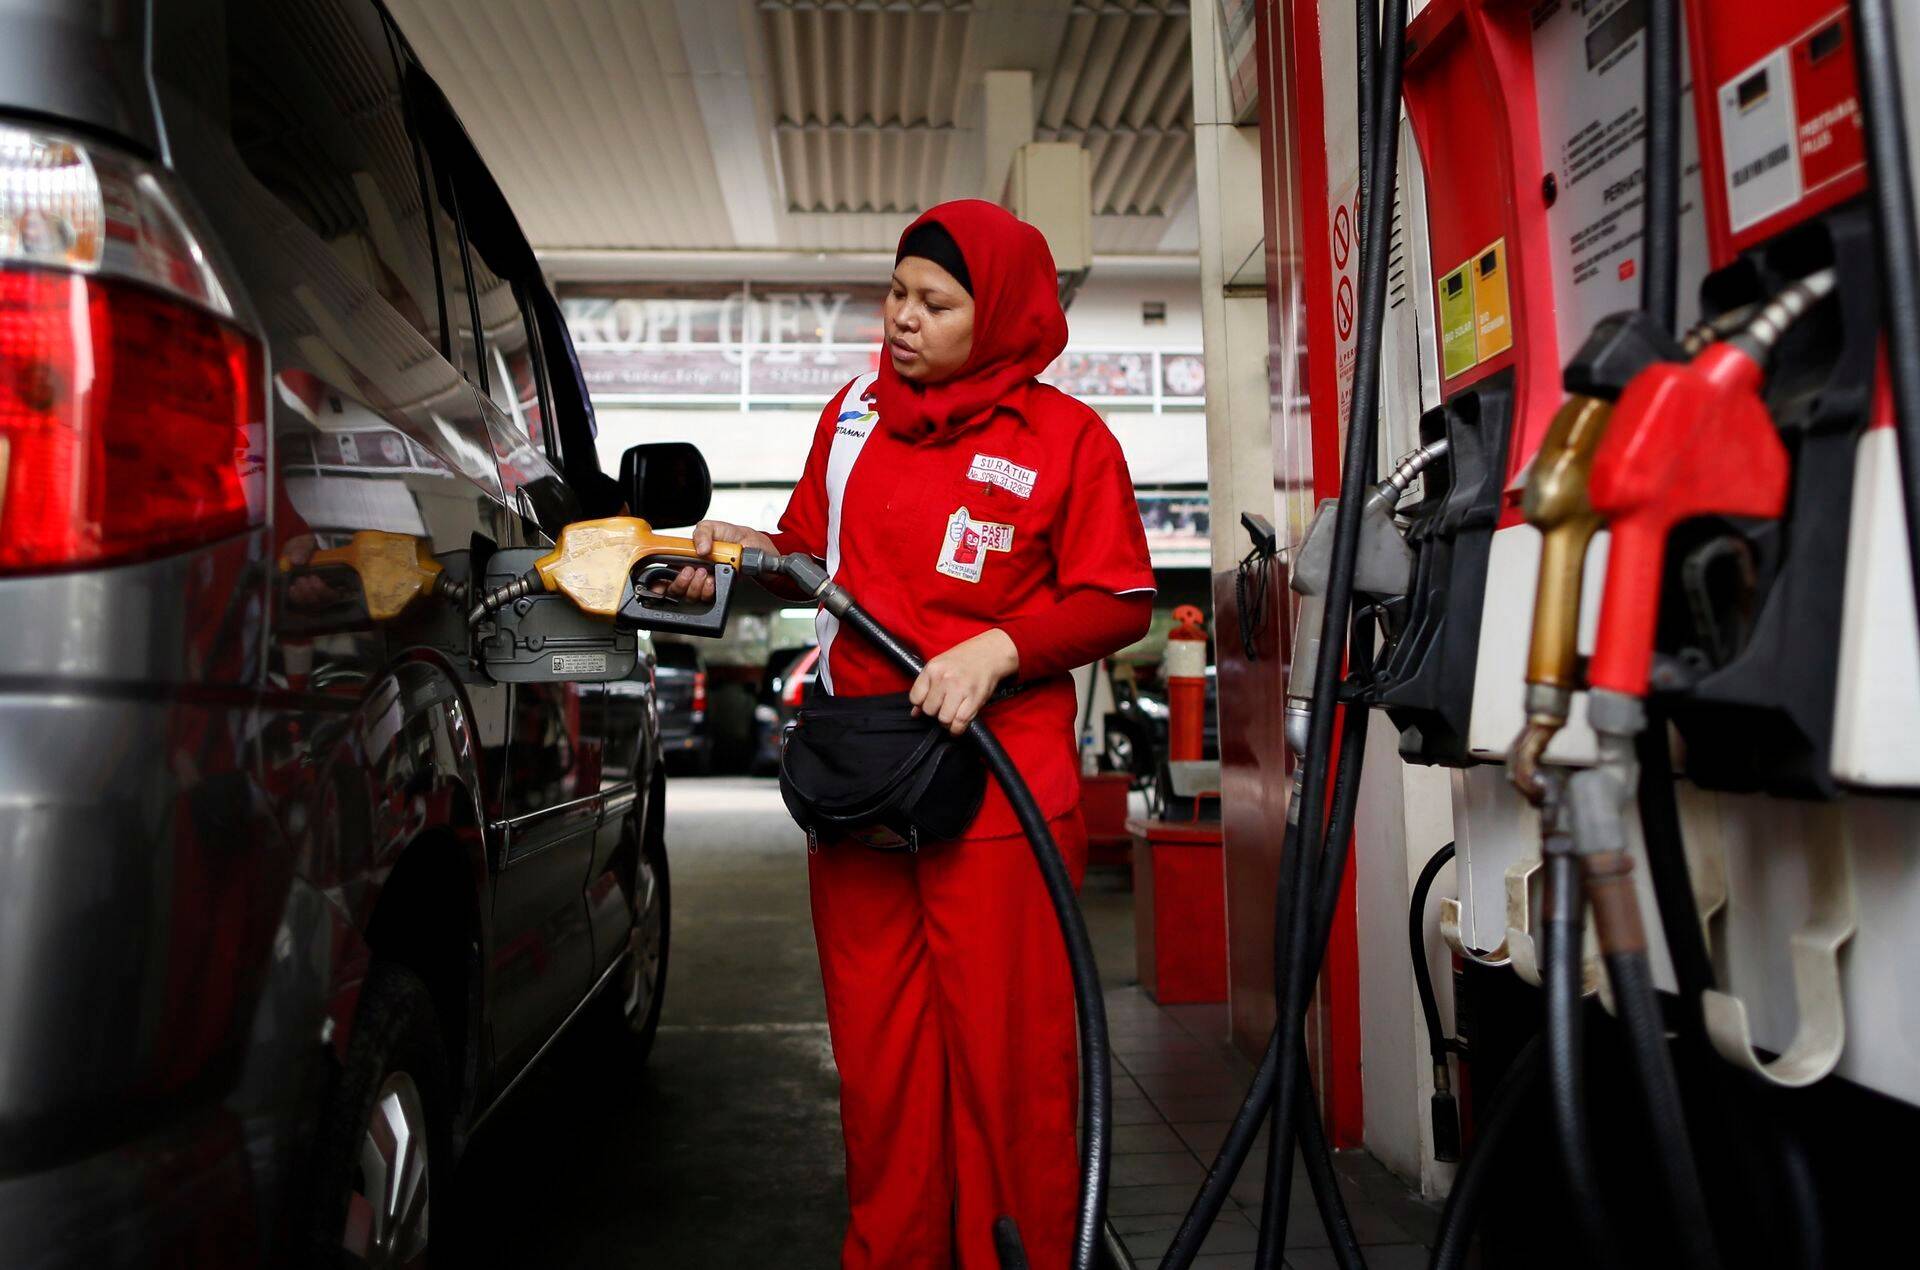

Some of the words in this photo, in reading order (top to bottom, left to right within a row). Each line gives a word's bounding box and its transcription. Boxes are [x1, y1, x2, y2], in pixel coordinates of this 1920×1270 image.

[564, 299, 697, 355] KOPI
[717, 293, 852, 364] OEY
[980, 458, 1031, 483] SURATIH
[982, 525, 1010, 539] PASTI
